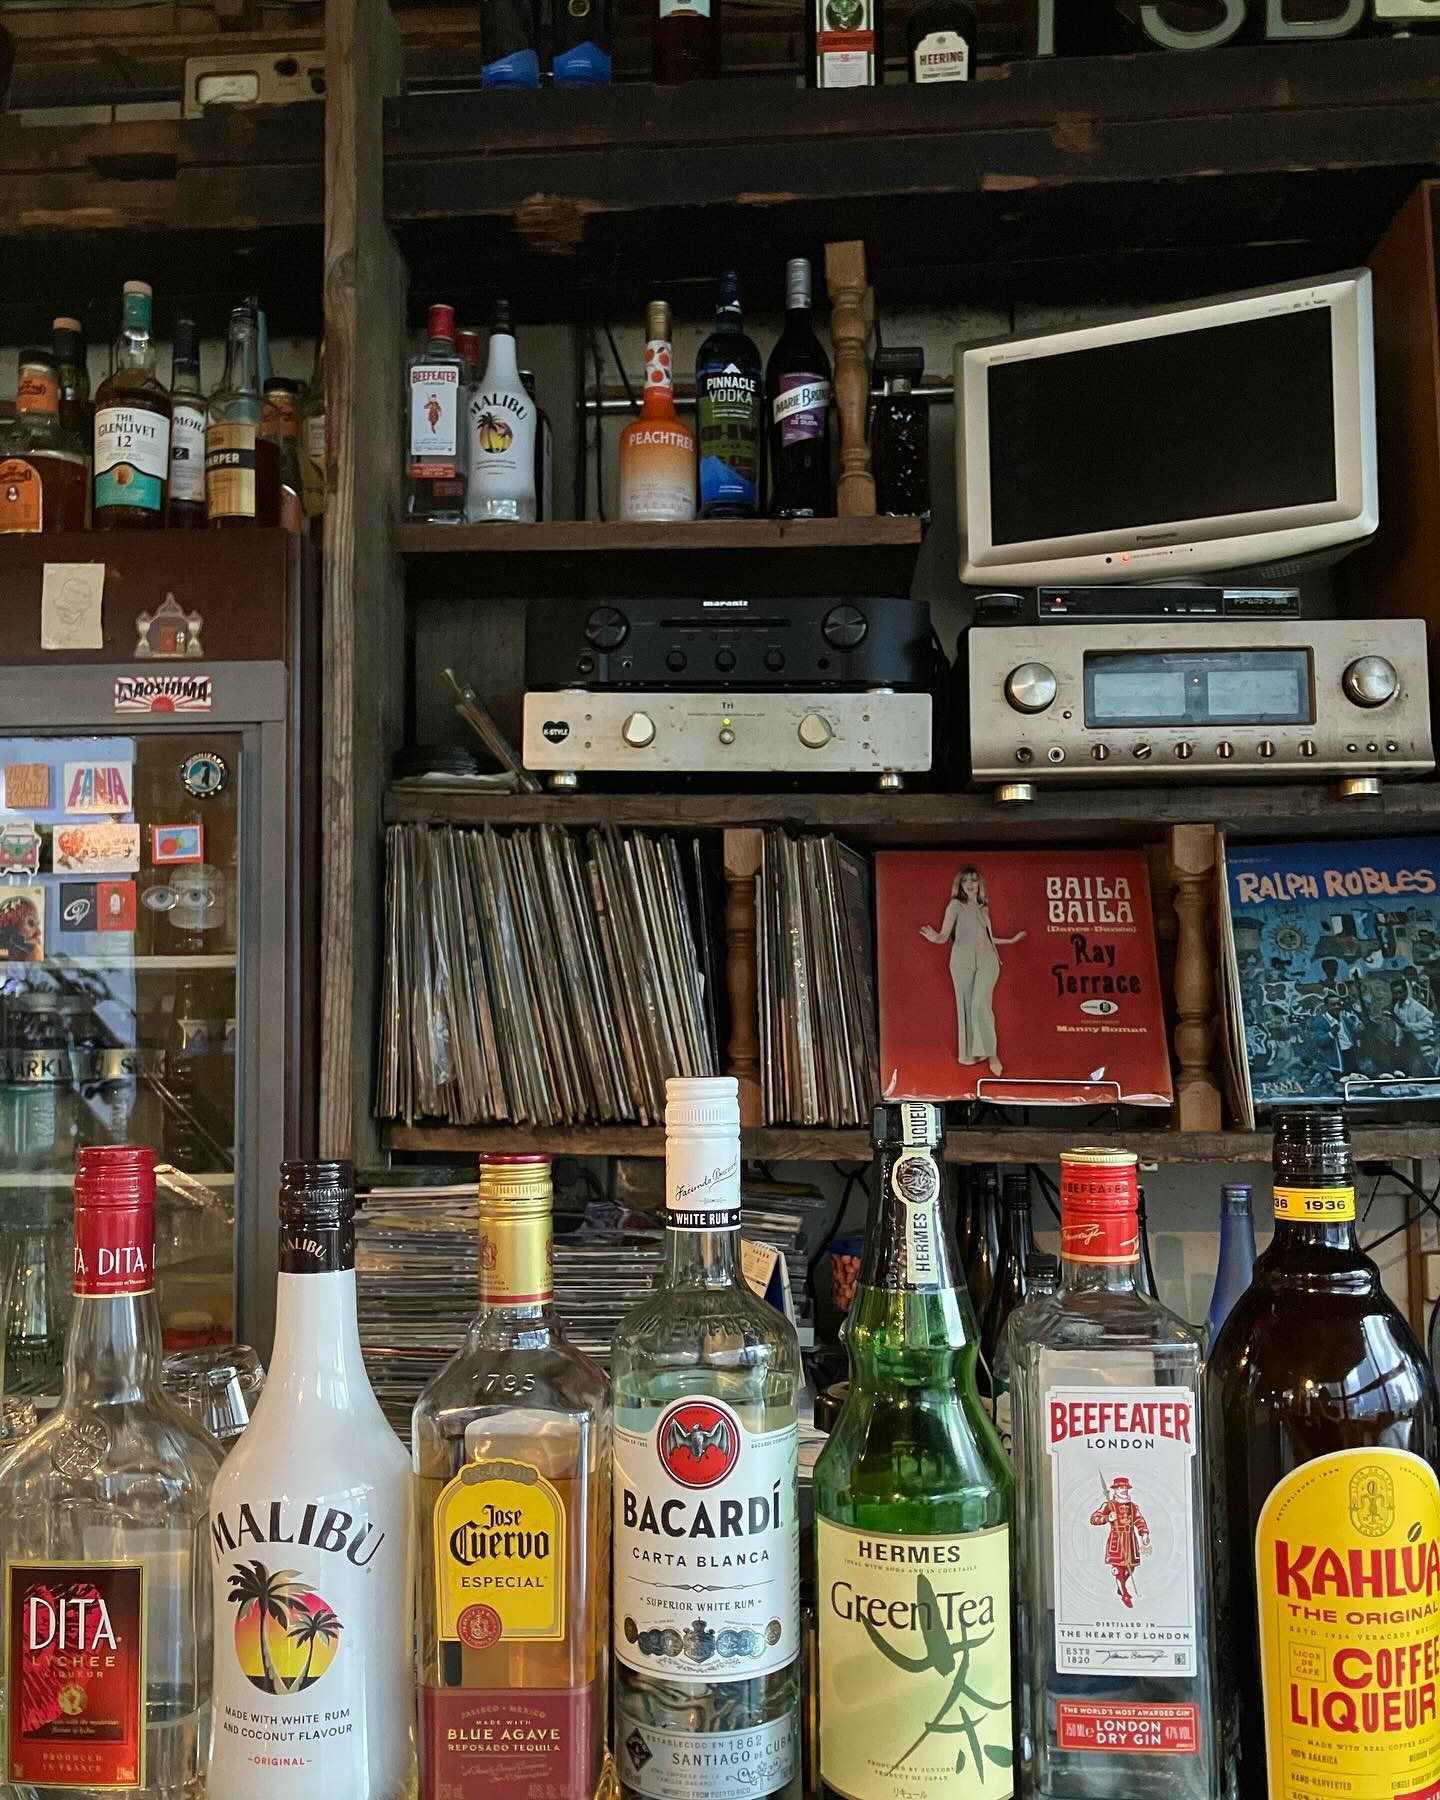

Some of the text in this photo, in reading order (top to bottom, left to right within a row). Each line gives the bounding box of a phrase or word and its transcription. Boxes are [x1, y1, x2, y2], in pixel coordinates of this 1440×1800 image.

[919, 51, 964, 66] HEERING
[412, 371, 457, 384] BEEFEATER
[706, 377, 757, 392] PINNACLE
[709, 389, 753, 404] VODKA
[470, 393, 529, 420] MALIBU
[116, 414, 133, 422] THE
[98, 423, 156, 438] GLENLIVET
[117, 435, 132, 448] 12
[544, 728, 569, 736] K-STYLE
[67, 768, 129, 807] FANIA
[1046, 876, 1131, 900] BAILA
[1235, 867, 1437, 903] RALPH ROBLES
[1048, 900, 1134, 923] BAILA
[1070, 933, 1116, 967] Ray
[1052, 964, 1142, 996] Terrace
[1056, 1025, 1147, 1034] Manny Roman
[1062, 1183, 1129, 1194] BEEFEATER
[1304, 1200, 1346, 1210] 1936
[676, 1213, 729, 1225] WHITE RUM
[913, 1212, 931, 1272] HERMES
[98, 1247, 144, 1275] DITA
[472, 1373, 536, 1393] 1795
[1050, 1402, 1191, 1444] BEEFEATER
[1086, 1439, 1155, 1449] LONDON
[623, 1478, 782, 1539] BACARDÍ
[482, 1504, 522, 1530] Jose
[211, 1501, 385, 1566] MALIBU
[450, 1520, 549, 1566] Cuervo
[632, 1547, 770, 1568] CARTA BLANCA
[859, 1541, 961, 1563] HERMES
[461, 1576, 544, 1588] ESPECIAL
[646, 1597, 754, 1612] SUPERIOR WHITE RUM
[831, 1581, 995, 1630] Green Tea
[1288, 1602, 1438, 1625] THE ORIGINAL
[30, 1597, 118, 1650] DITA
[1060, 1630, 1077, 1638] THE
[1085, 1631, 1121, 1639] HEART
[1143, 1632, 1190, 1640] LONDON
[32, 1655, 116, 1668] LYCHEE
[1067, 1656, 1090, 1664] 1820
[1293, 1649, 1321, 1661] LICOR
[1301, 1659, 1313, 1667] DE
[43, 1670, 104, 1679] LIQUEUR
[225, 1705, 351, 1725] MADE WITH WHITE RUM
[460, 1705, 500, 1719] JALISCO
[1115, 1708, 1136, 1716] MOST
[1290, 1682, 1437, 1734] LIQUEUR
[223, 1721, 353, 1741] AND COCONUT FLAVOUR
[1096, 1720, 1161, 1732] LONDON
[448, 1728, 561, 1740] BLUE AGAVE
[1096, 1733, 1162, 1744] DRY GIN
[448, 1744, 561, 1752] REPOSADO TEQUILA
[646, 1735, 763, 1751] ESTABLECIDO EN 1862
[672, 1750, 750, 1766] SANTIAGO
[766, 1735, 792, 1756] CUBA
[1307, 1740, 1332, 1749] MADE
[1337, 1744, 1360, 1752] WITH
[1388, 1741, 1416, 1751] COFFEE
[43, 1752, 103, 1761] PRODUCED
[60, 1763, 102, 1773] FRANCE
[892, 1786, 928, 1799] リキュール
